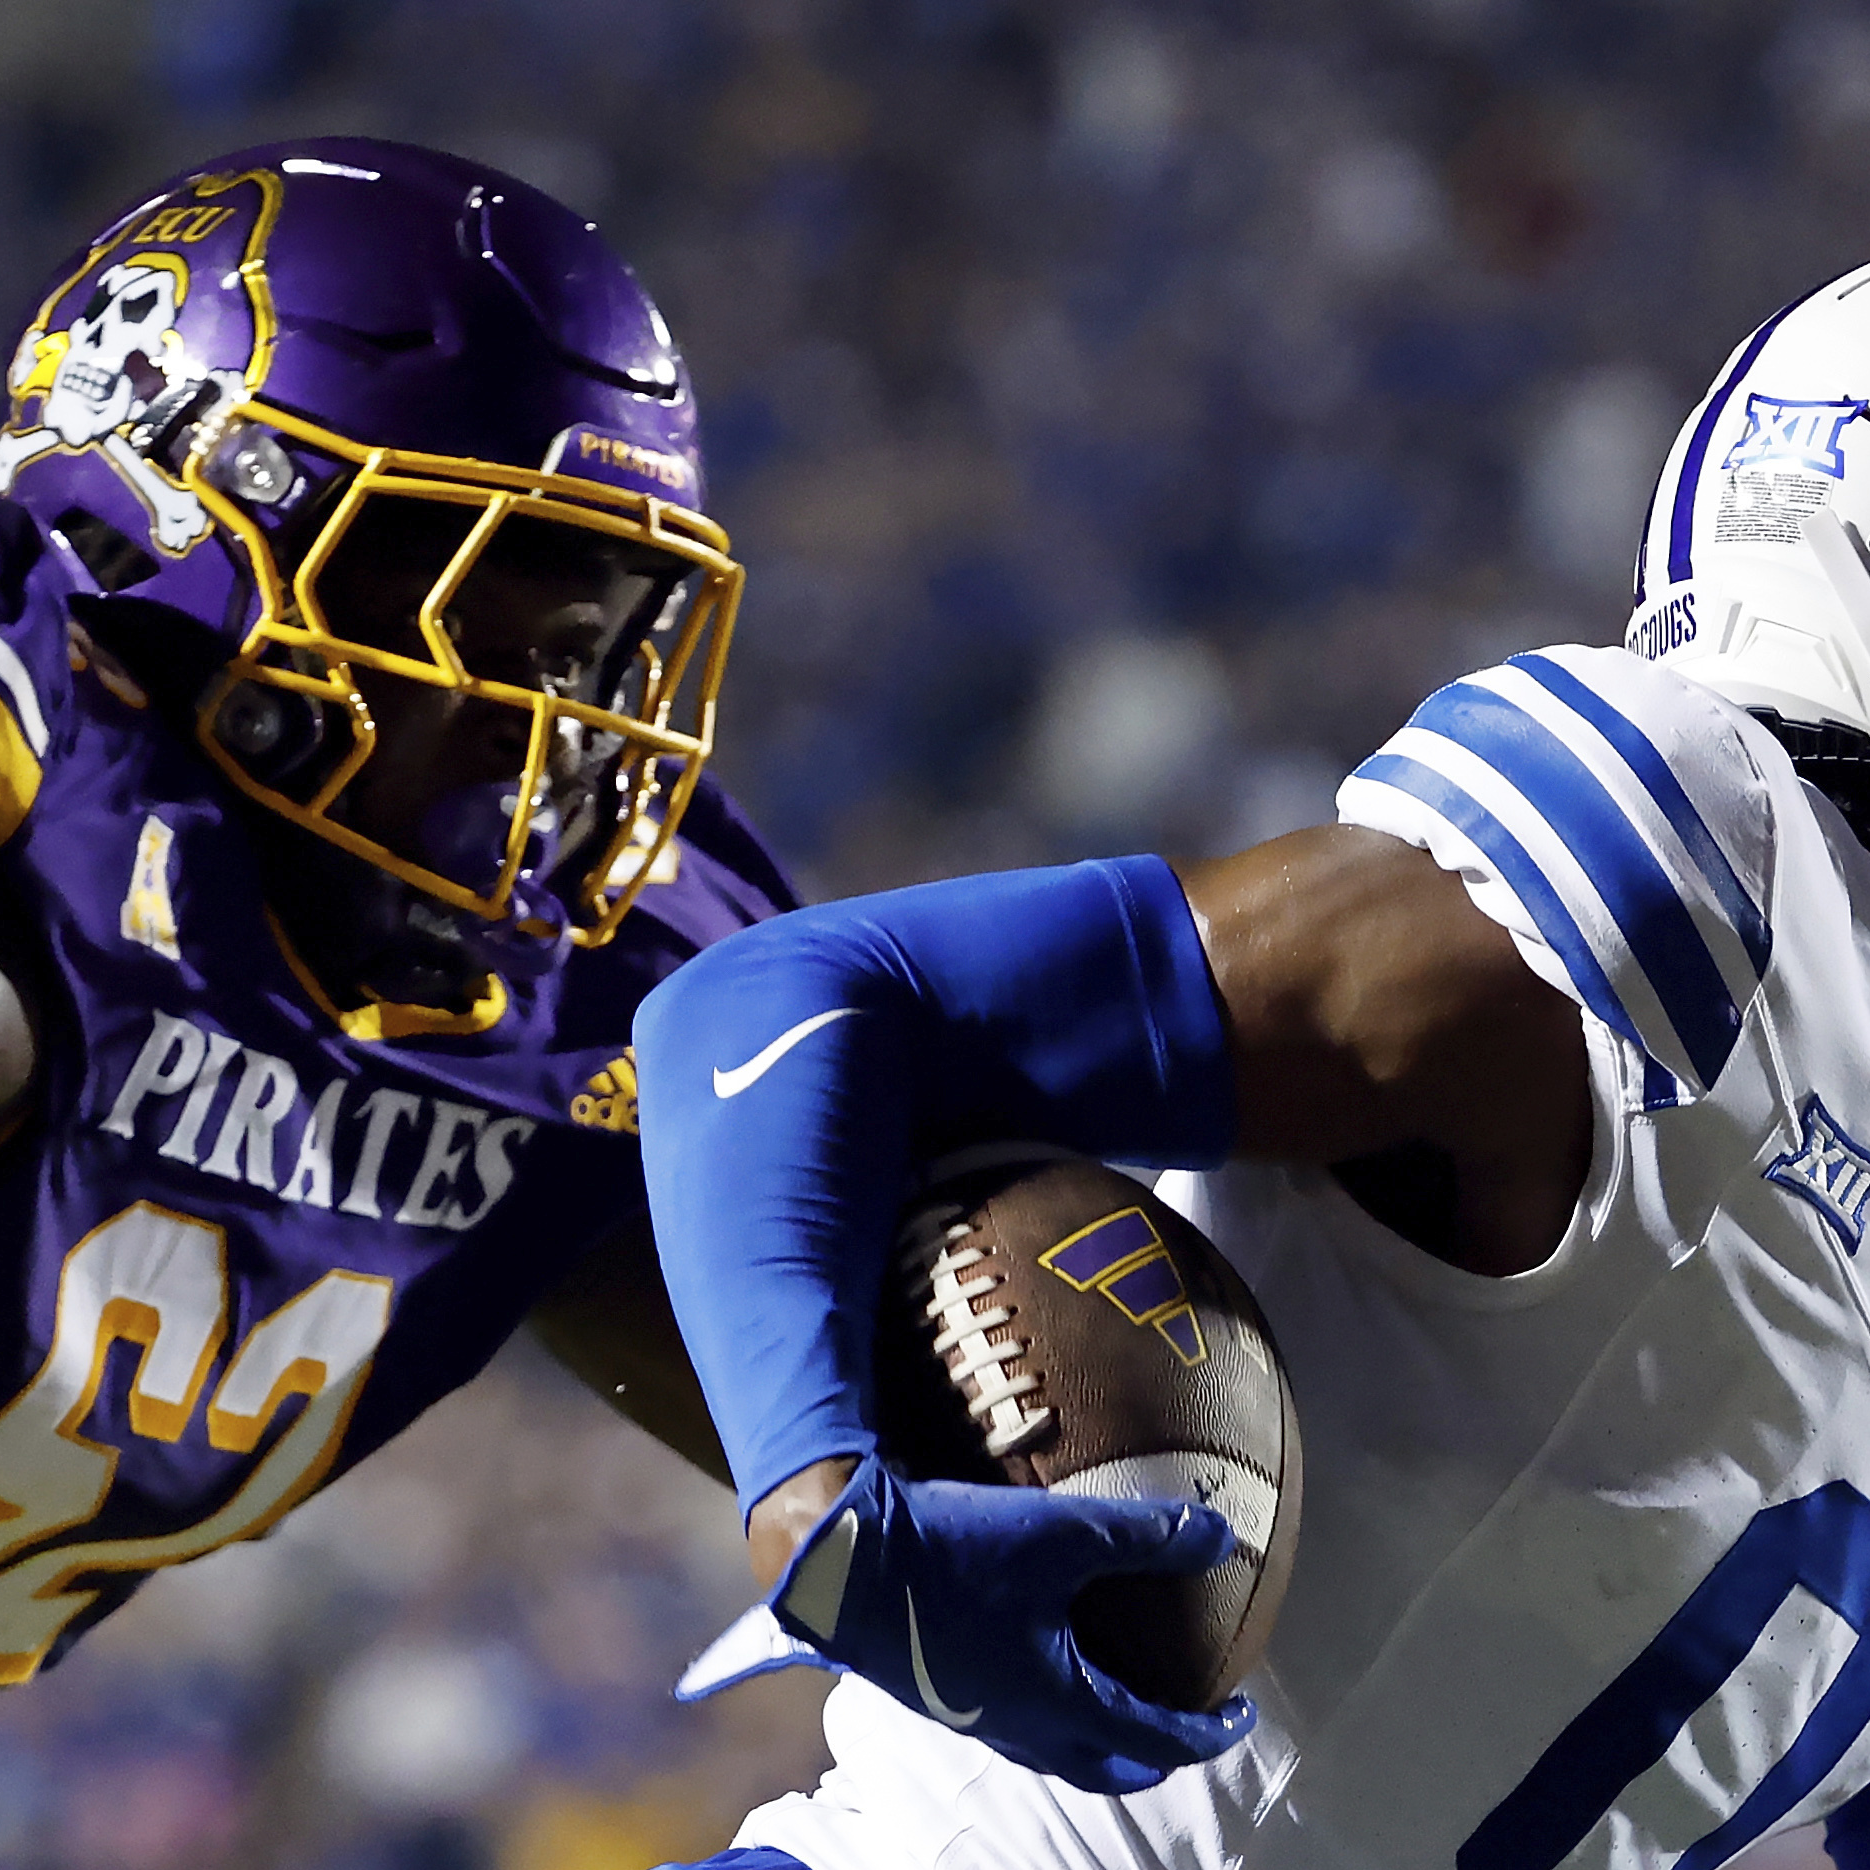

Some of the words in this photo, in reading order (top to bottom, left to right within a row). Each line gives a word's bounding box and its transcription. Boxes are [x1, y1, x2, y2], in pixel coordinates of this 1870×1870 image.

[131, 206, 237, 243] ECU
[579, 431, 686, 489] PIRATES
[1726, 397, 1863, 472] XII
[1641, 592, 1697, 662] COUGS
[98, 1008, 538, 1232] PIRATES
